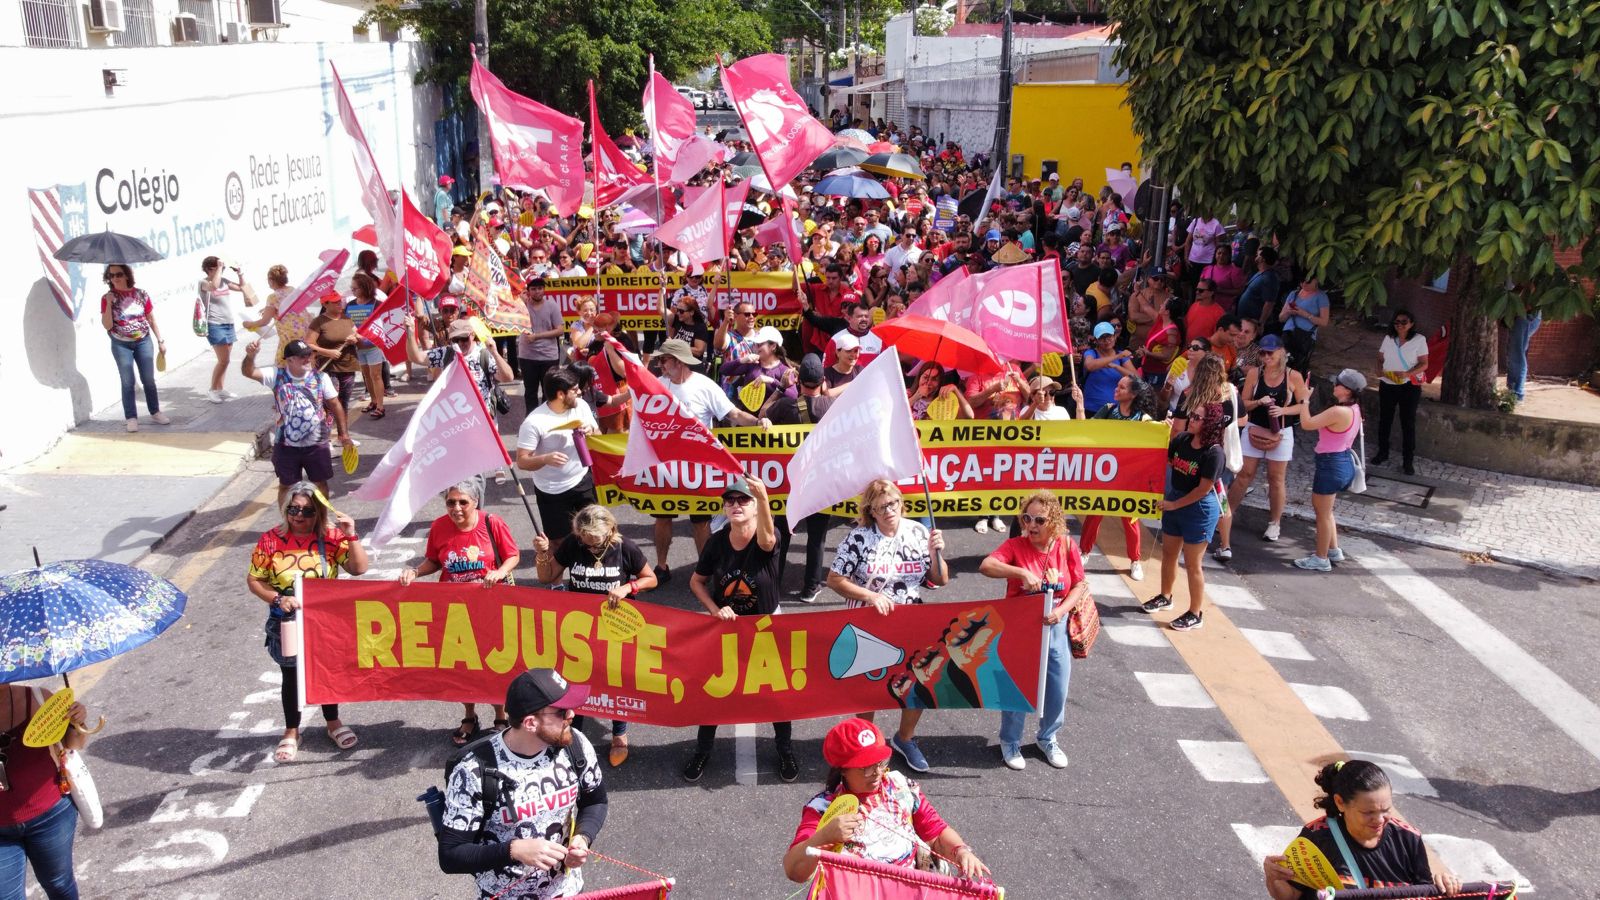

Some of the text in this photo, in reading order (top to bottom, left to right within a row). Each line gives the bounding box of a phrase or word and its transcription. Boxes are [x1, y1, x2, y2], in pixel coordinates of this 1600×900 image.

[95, 167, 179, 214] Colégio
[249, 154, 280, 189] Rede
[253, 186, 325, 231] de Educação
[543, 278, 602, 288] NENHUM
[607, 276, 660, 287] DIREITO
[666, 276, 675, 286] A
[929, 427, 944, 441] A
[952, 425, 1042, 441] MENOS!
[661, 499, 690, 512] OS
[355, 600, 808, 704] REAJUSTE, JÁ!
[501, 783, 579, 824] UNI-VOS
